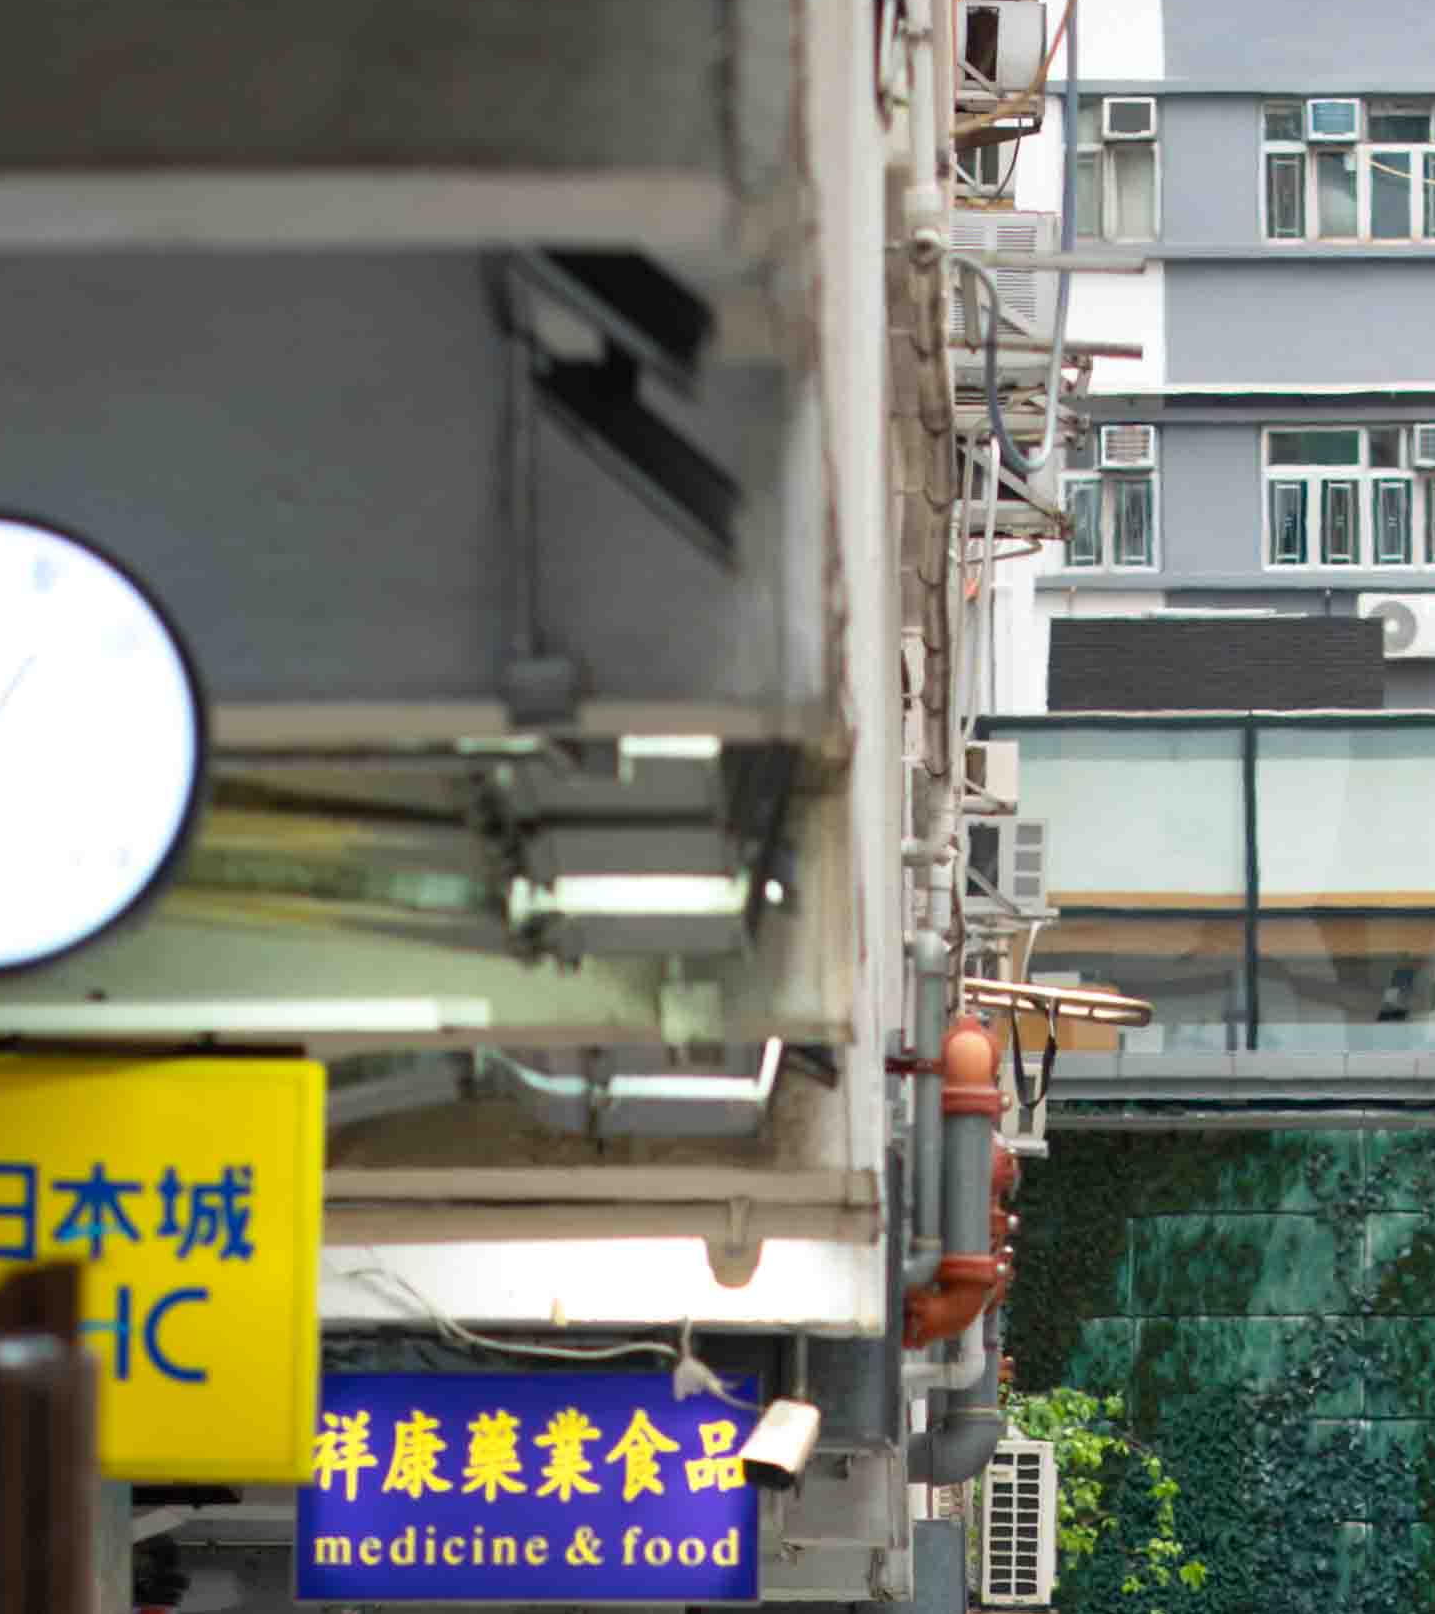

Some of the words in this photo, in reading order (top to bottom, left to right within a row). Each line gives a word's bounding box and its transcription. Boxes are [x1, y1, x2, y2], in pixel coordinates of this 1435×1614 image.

[313, 1407, 747, 1503] 祥康藥業食品
[313, 1525, 549, 1566] medicine
[566, 1524, 603, 1567] &
[622, 1525, 740, 1567] food
